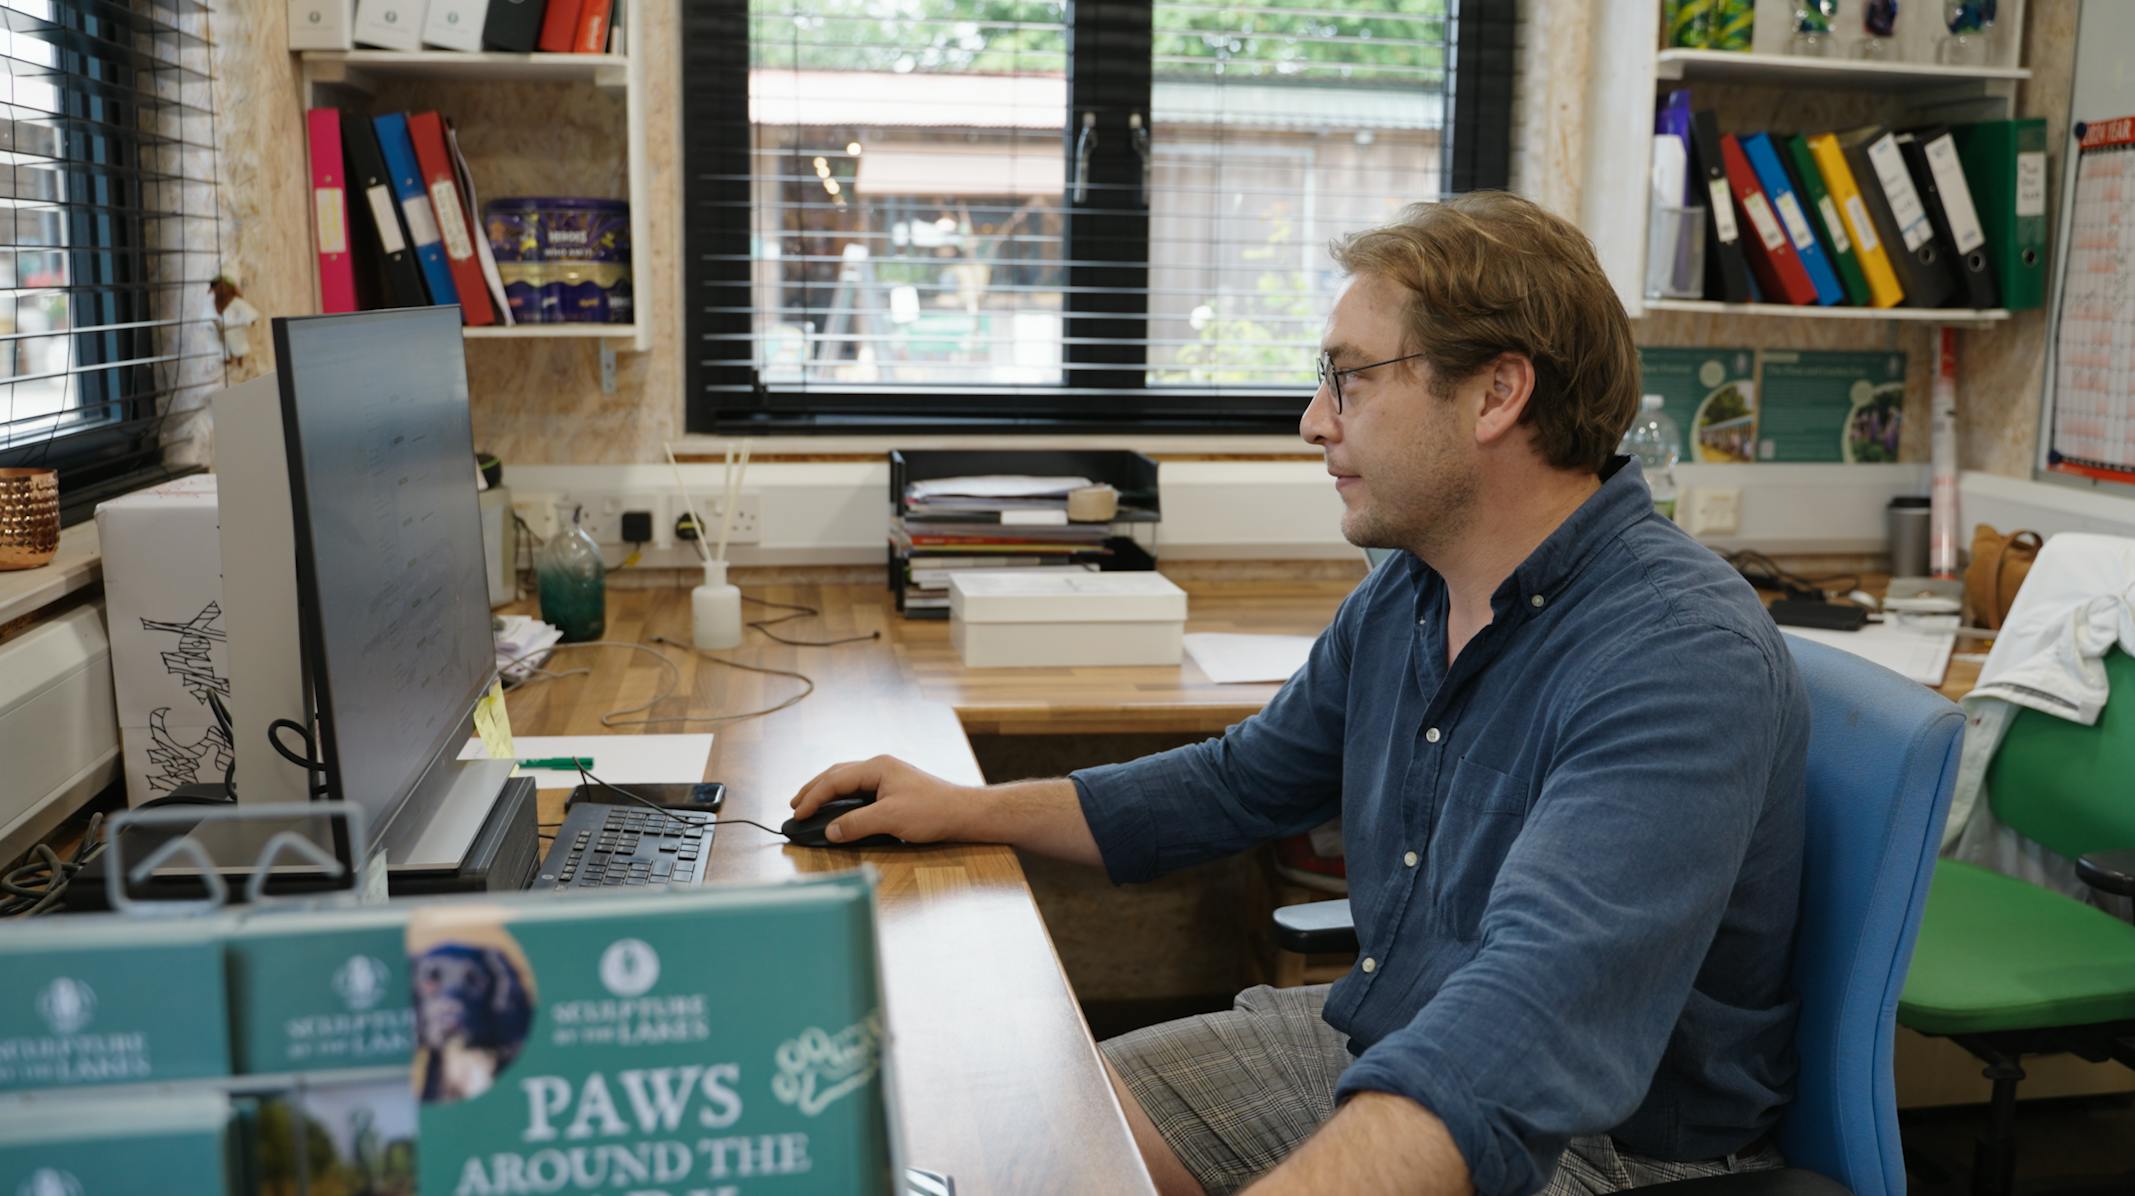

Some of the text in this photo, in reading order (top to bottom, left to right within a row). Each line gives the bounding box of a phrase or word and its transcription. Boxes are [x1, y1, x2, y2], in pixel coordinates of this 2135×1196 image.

[285, 1007, 417, 1039] SCULPTU
[551, 994, 709, 1024] SCULPTURE
[0, 1030, 147, 1061] CULPTURE
[520, 1062, 744, 1142] PAWS
[453, 1132, 812, 1196] AROUND THE
